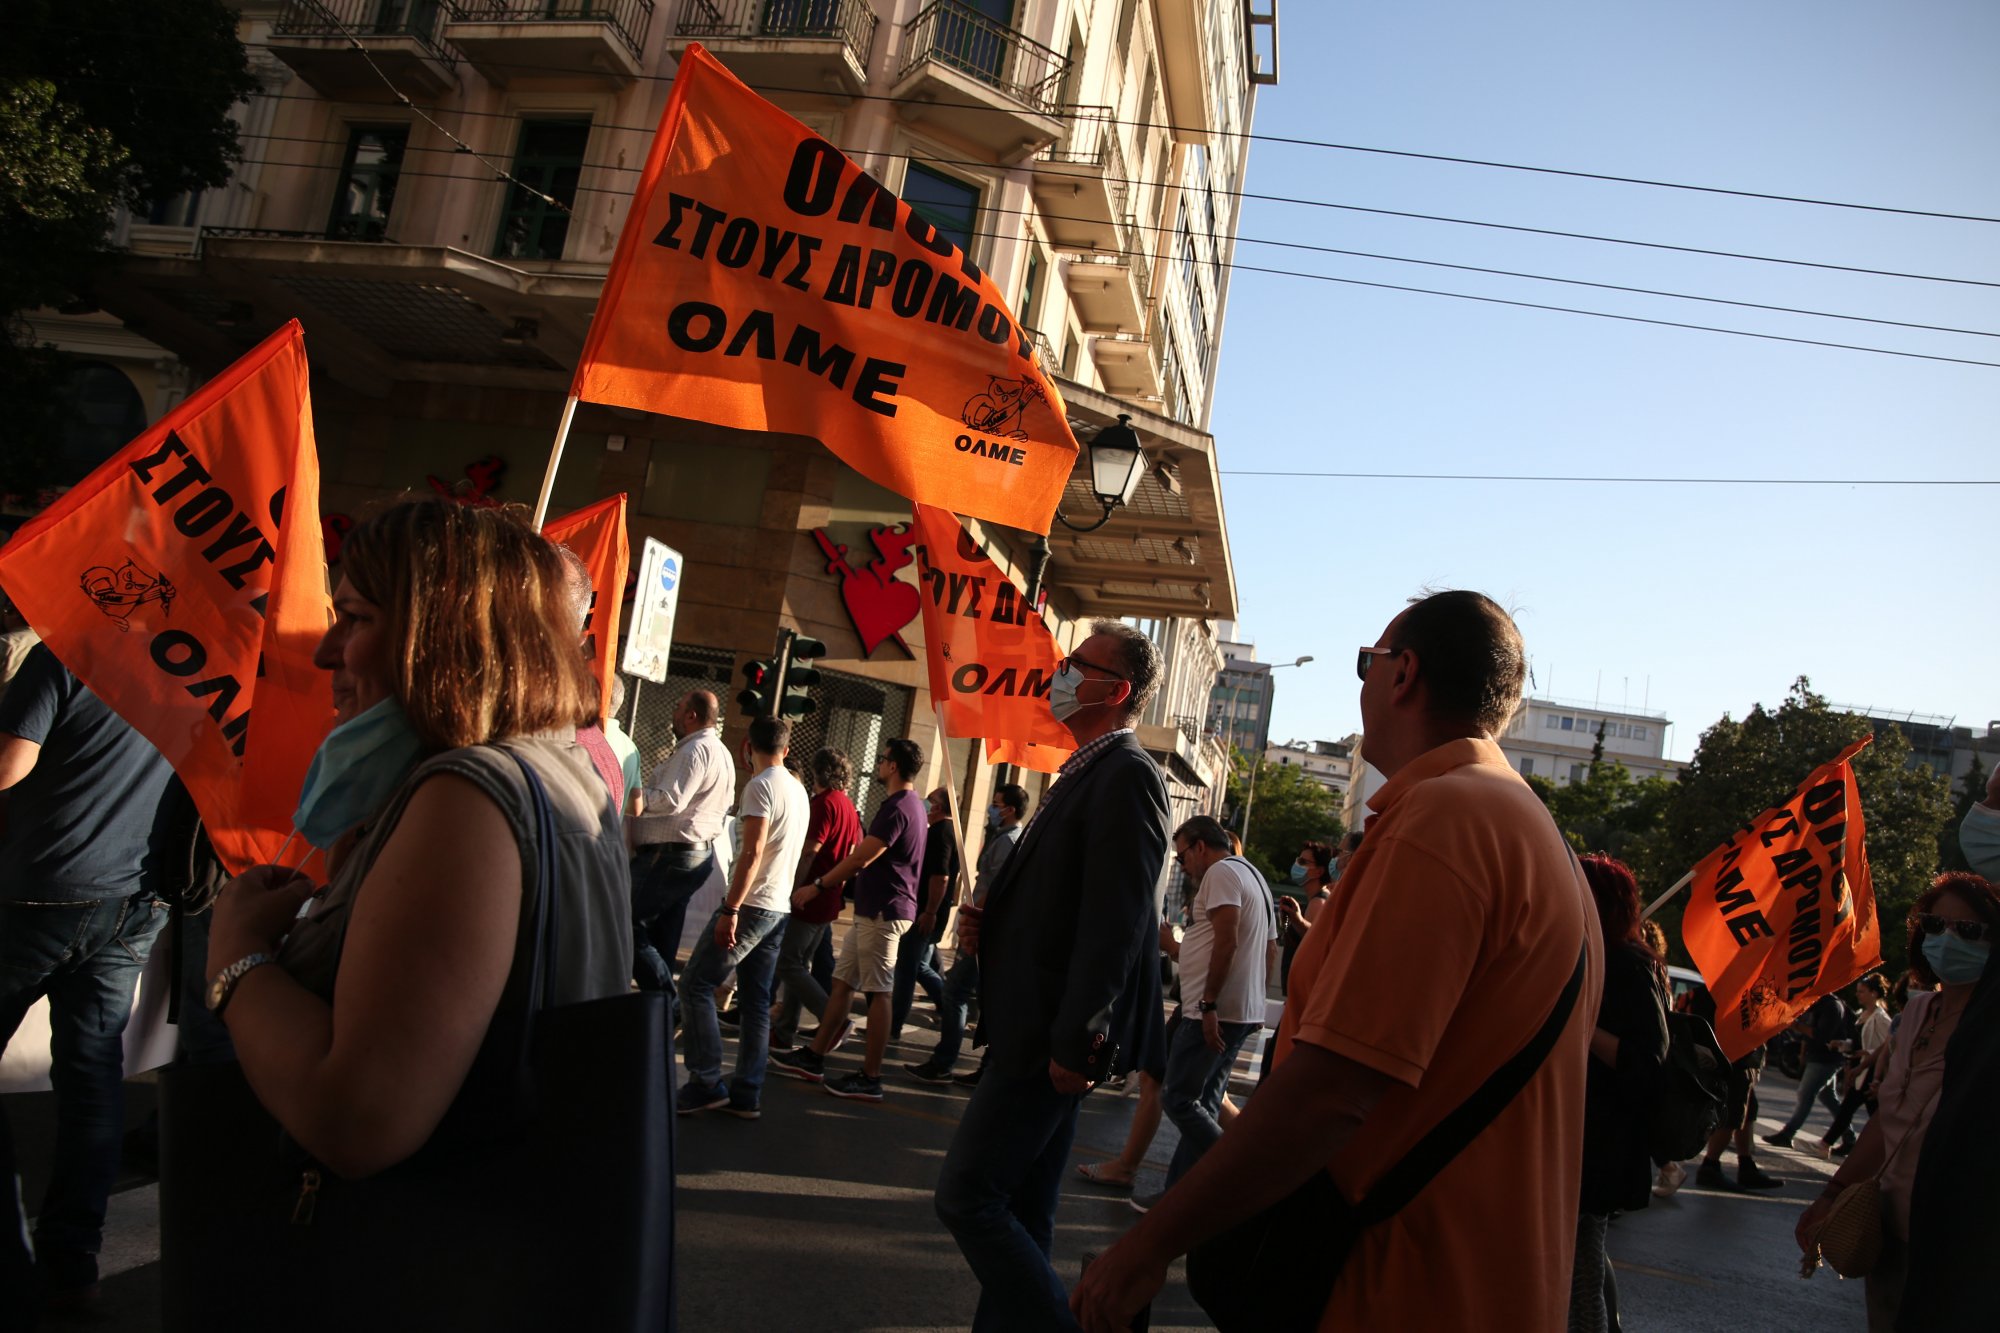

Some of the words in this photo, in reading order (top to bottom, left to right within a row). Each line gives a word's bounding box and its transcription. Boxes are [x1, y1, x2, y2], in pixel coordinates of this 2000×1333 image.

[652, 192, 822, 292] ΣΤΟΥΣ
[822, 243, 1054, 388] ΔΡΟΜΟΥ
[667, 301, 907, 418] ΟΛΜΕ
[955, 434, 1027, 466] ΟΛΜΕ
[129, 429, 276, 591] ΣΤΟΥΣ
[952, 663, 1054, 700] ΟΛΜ
[1714, 838, 1775, 948] ΛΜΕ
